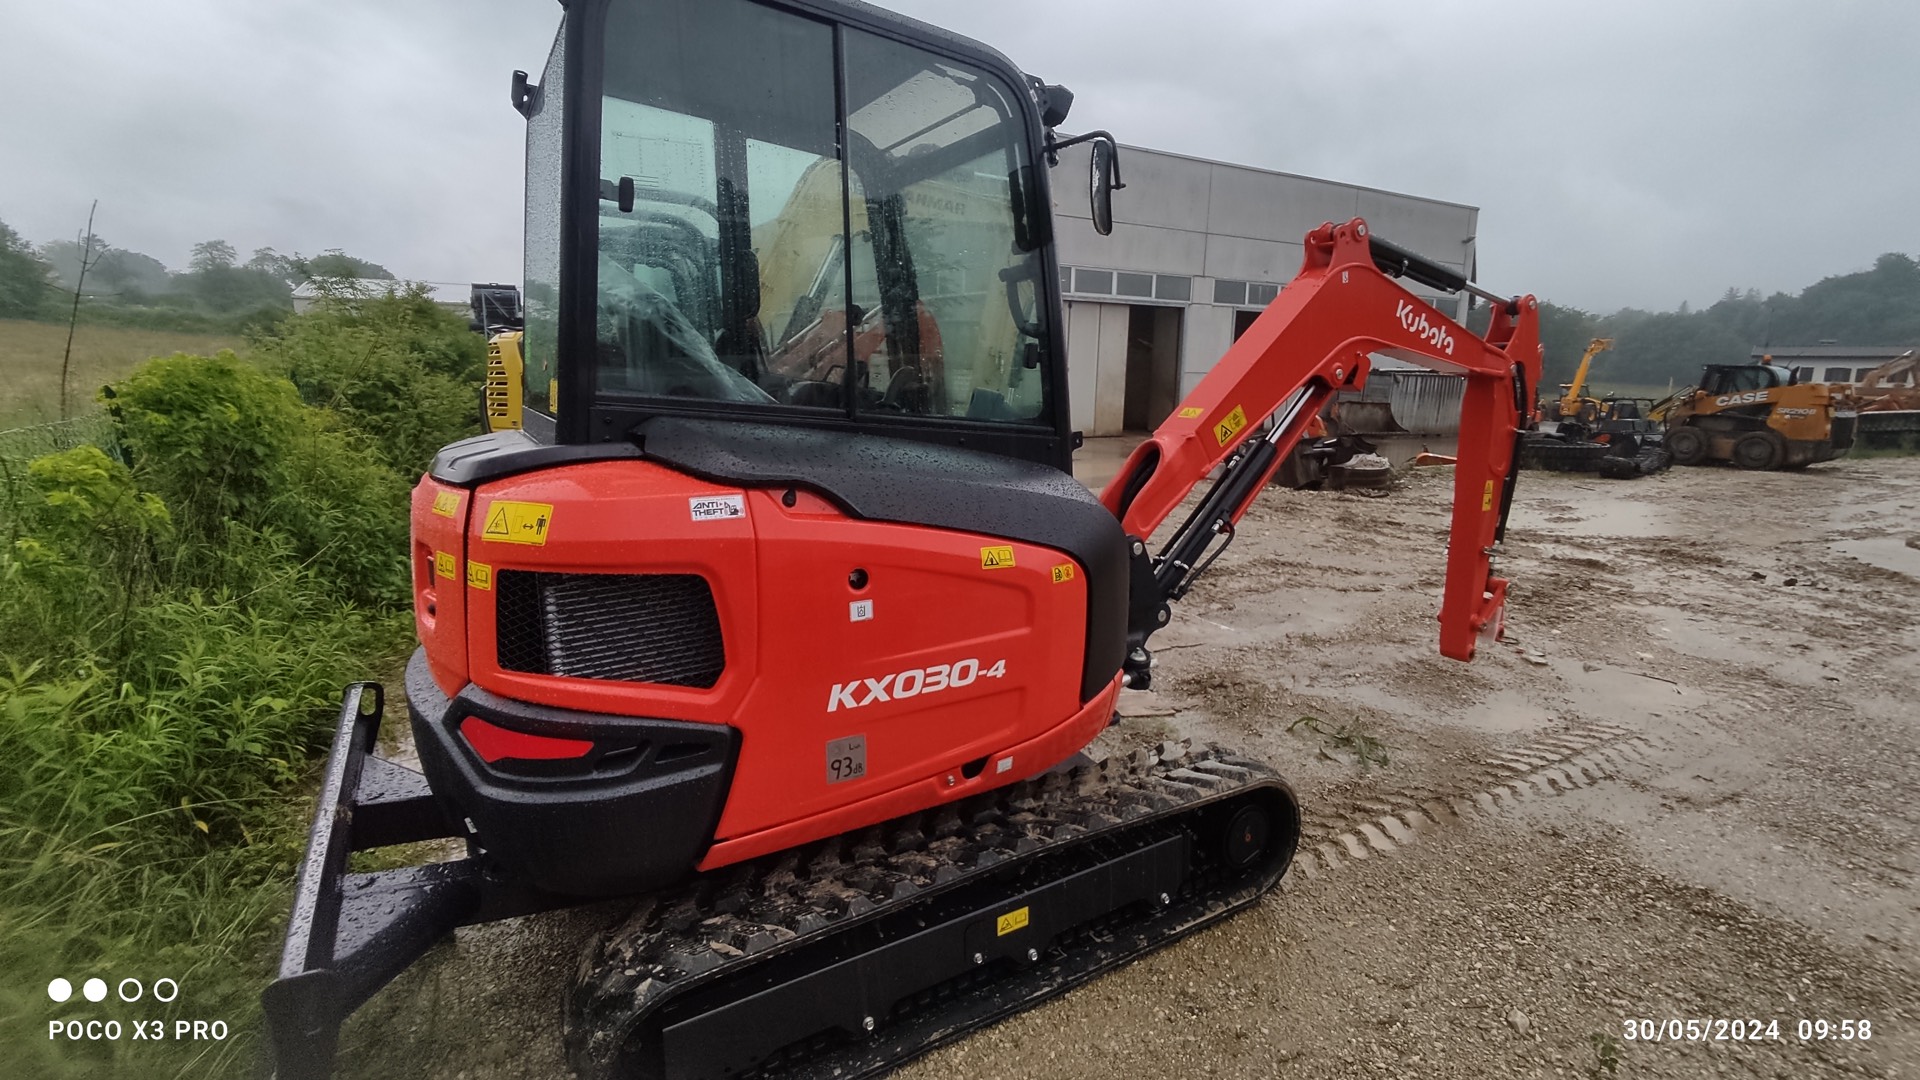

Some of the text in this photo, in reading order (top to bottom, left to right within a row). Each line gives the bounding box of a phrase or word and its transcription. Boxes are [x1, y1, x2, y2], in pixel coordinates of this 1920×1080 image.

[1396, 299, 1454, 355] Kubota
[1715, 390, 1769, 407] CASE
[692, 508, 723, 516] THEFT
[826, 658, 1006, 713] KX030-4
